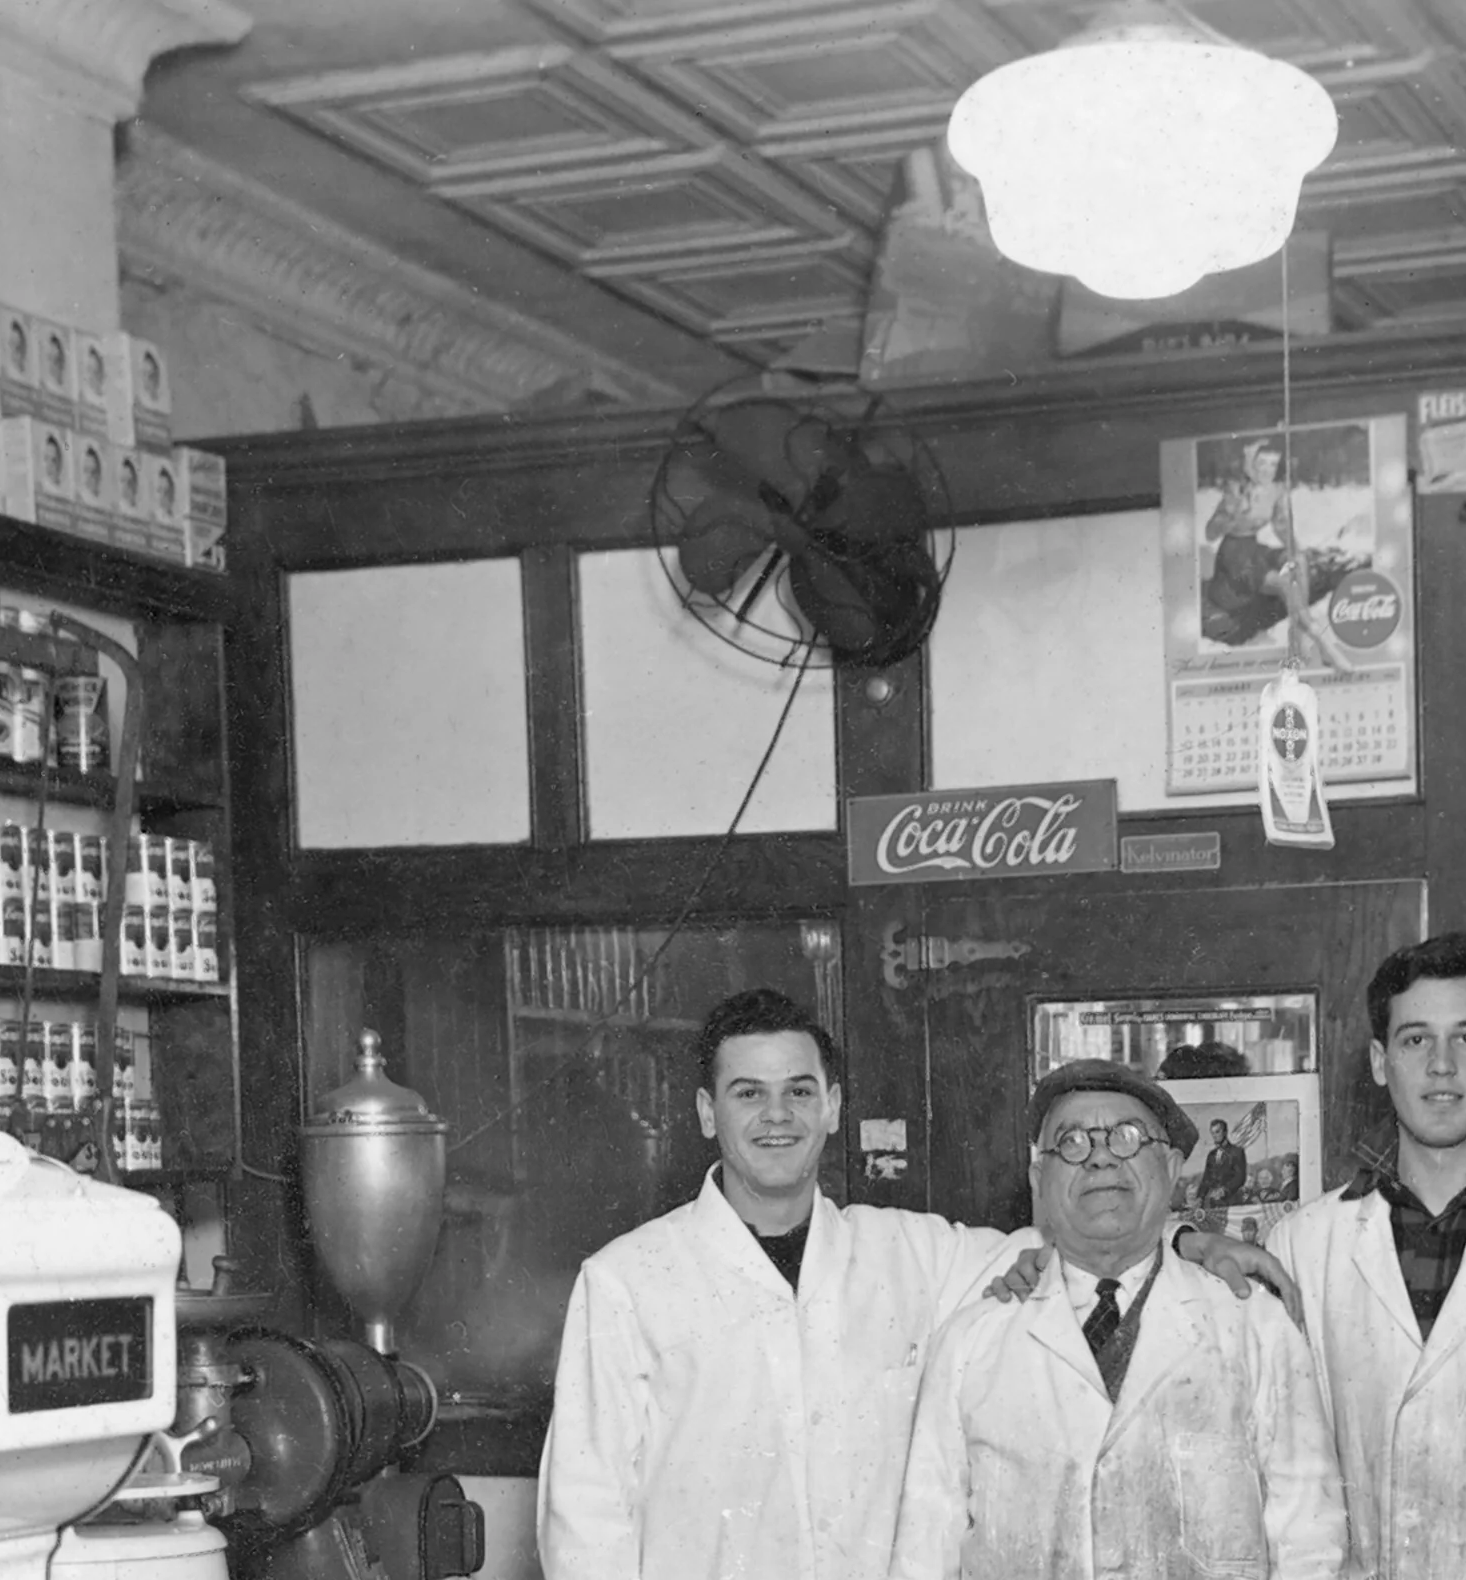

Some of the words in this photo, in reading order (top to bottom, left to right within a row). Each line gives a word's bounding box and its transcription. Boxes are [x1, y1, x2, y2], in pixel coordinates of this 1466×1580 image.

[1332, 593, 1396, 624] Coca-Cola
[927, 799, 986, 816] DRINK
[876, 793, 1082, 874] Coca-Cola
[1125, 837, 1215, 865] Kelvinator
[21, 1334, 132, 1384] MARKET
